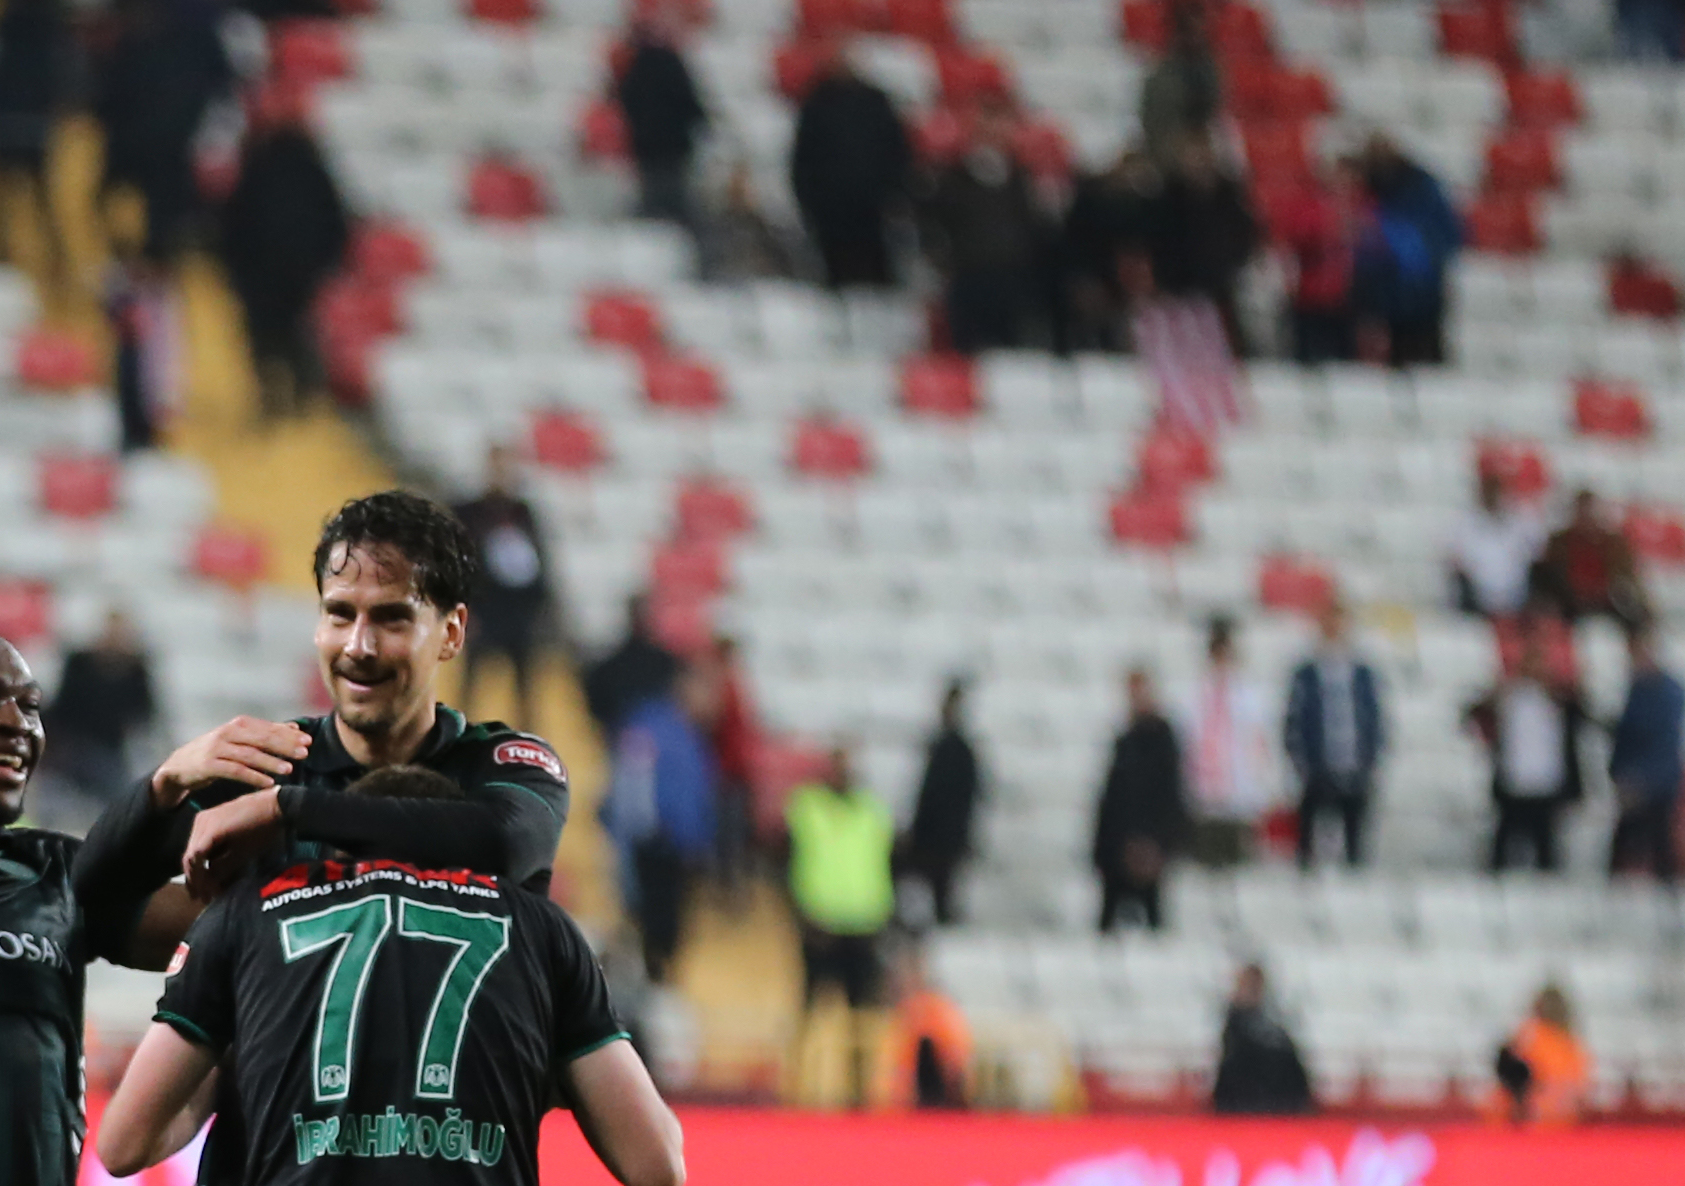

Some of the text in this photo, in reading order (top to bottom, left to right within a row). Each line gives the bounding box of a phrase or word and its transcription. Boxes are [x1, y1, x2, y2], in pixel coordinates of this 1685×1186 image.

[261, 883, 333, 912] AUTOGAS
[335, 869, 403, 892] SYSTEMS
[419, 879, 449, 892] LPG
[452, 882, 500, 899] TANKS
[280, 894, 512, 1103] 77
[292, 1104, 506, 1167] İBRAHİMOĞLU
